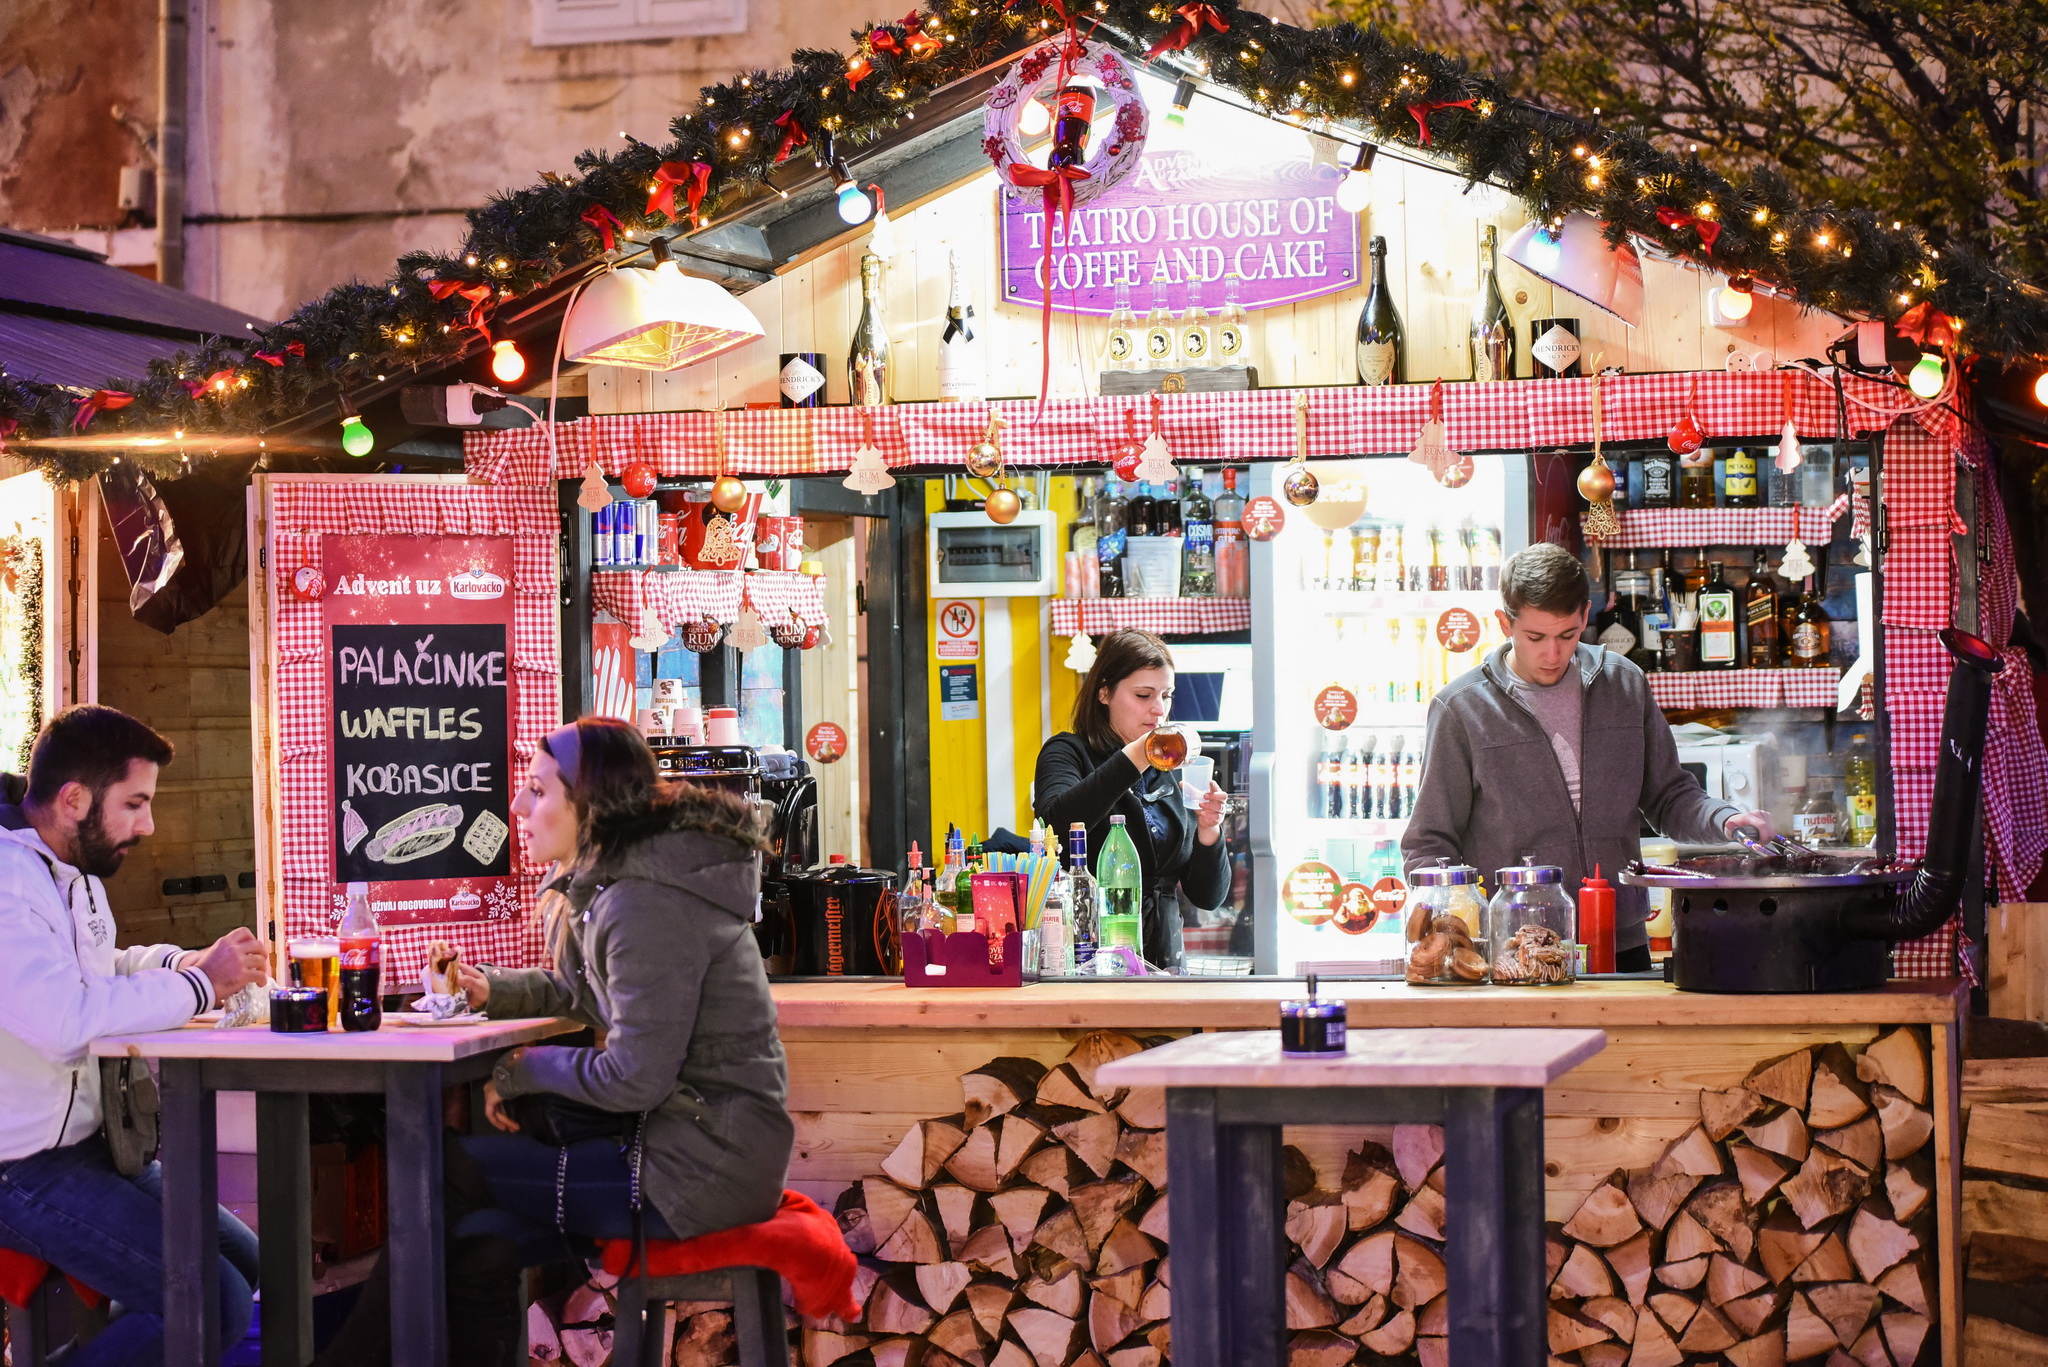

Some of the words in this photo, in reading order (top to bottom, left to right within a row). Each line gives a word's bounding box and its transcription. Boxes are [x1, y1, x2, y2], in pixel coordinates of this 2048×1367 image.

[1024, 205, 1157, 249] TEATRO
[1166, 199, 1281, 241] HOUSE
[1289, 196, 1334, 235] OF
[1034, 249, 1141, 291] COFFE
[1149, 244, 1225, 286] AND
[1234, 240, 1327, 281] CAKE
[1424, 448, 1445, 456] RUM
[1149, 461, 1166, 470] RUM
[858, 471, 880, 480] RUM
[586, 490, 601, 498] RUM
[333, 573, 412, 595] Advent
[416, 579, 442, 595] uz
[453, 581, 502, 594] Karlovačko
[737, 631, 754, 639] RUM
[776, 624, 807, 636] RUM
[688, 634, 718, 645] RUM
[339, 633, 507, 688] PALAČINKE
[340, 706, 483, 741] WAFFLES
[346, 762, 493, 797] KOBASICE
[1804, 814, 1838, 826] nutella
[371, 900, 397, 912] UŽIVAJ
[397, 898, 447, 911] ODGOVORNO!
